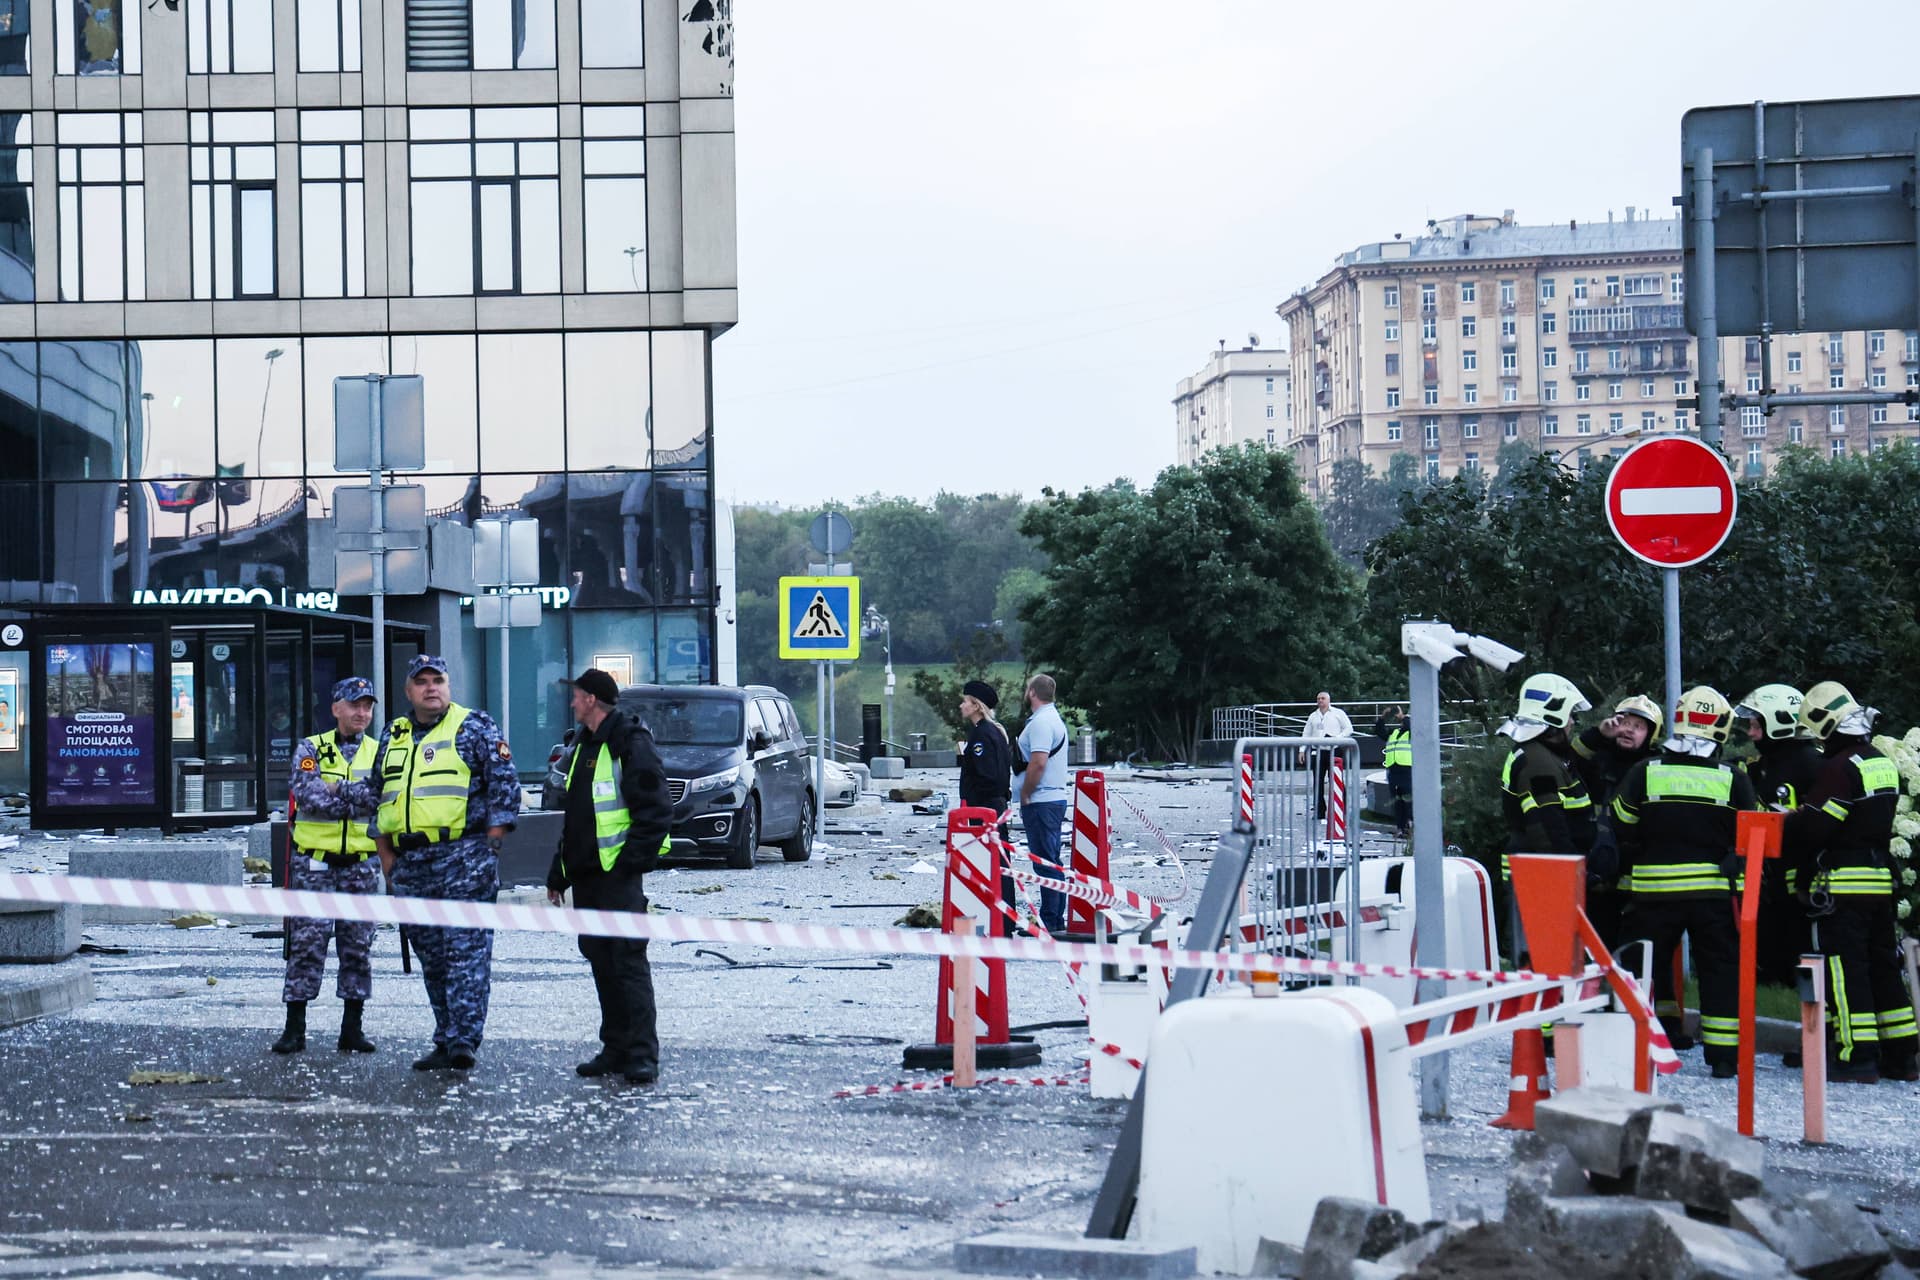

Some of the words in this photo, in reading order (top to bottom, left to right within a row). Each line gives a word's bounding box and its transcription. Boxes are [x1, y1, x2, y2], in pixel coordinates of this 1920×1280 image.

[132, 587, 273, 605] INVITRO
[1695, 701, 1715, 714] 791
[65, 725, 134, 734] СМОТРОВАЯ
[66, 736, 133, 746] ПЛОЩАДКА
[59, 748, 140, 757] PANORAMA360
